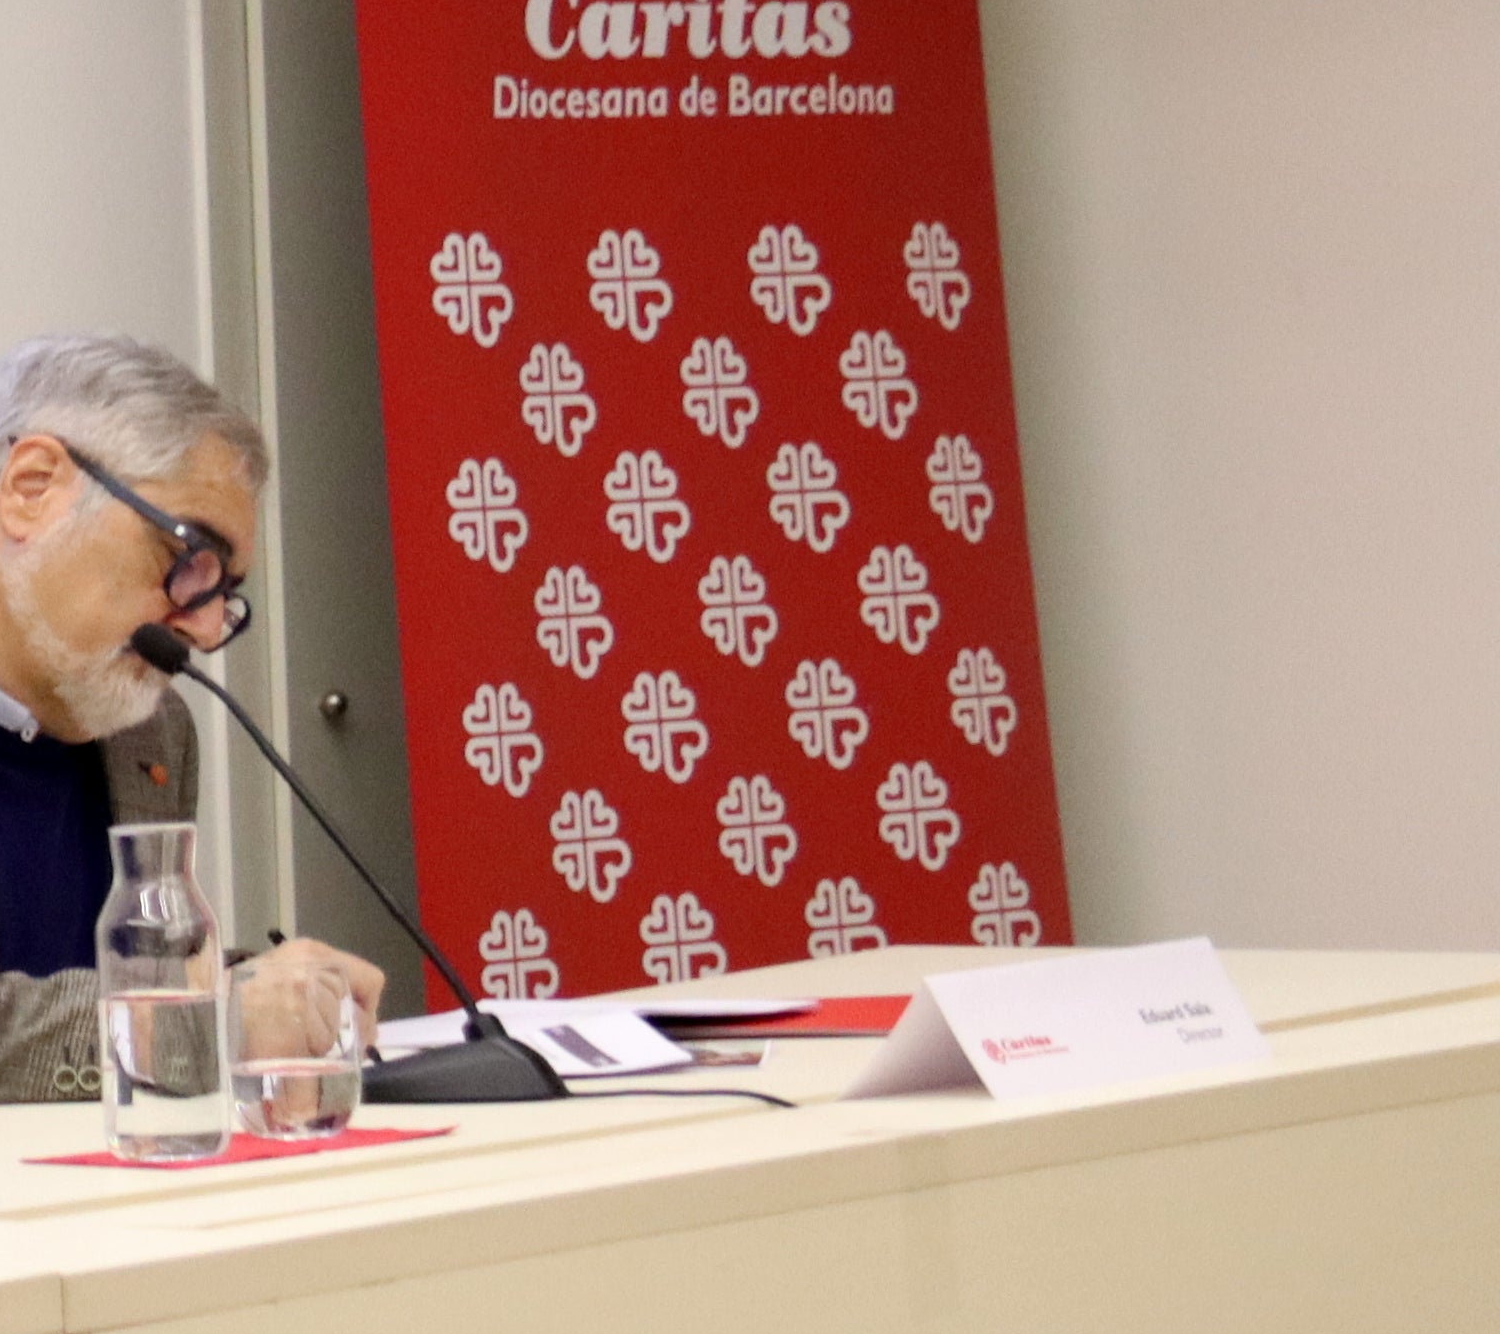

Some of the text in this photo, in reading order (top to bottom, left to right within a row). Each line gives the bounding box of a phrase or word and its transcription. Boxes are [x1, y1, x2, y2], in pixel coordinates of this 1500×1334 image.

[493, 73, 894, 119] Diocesana de Barcelona
